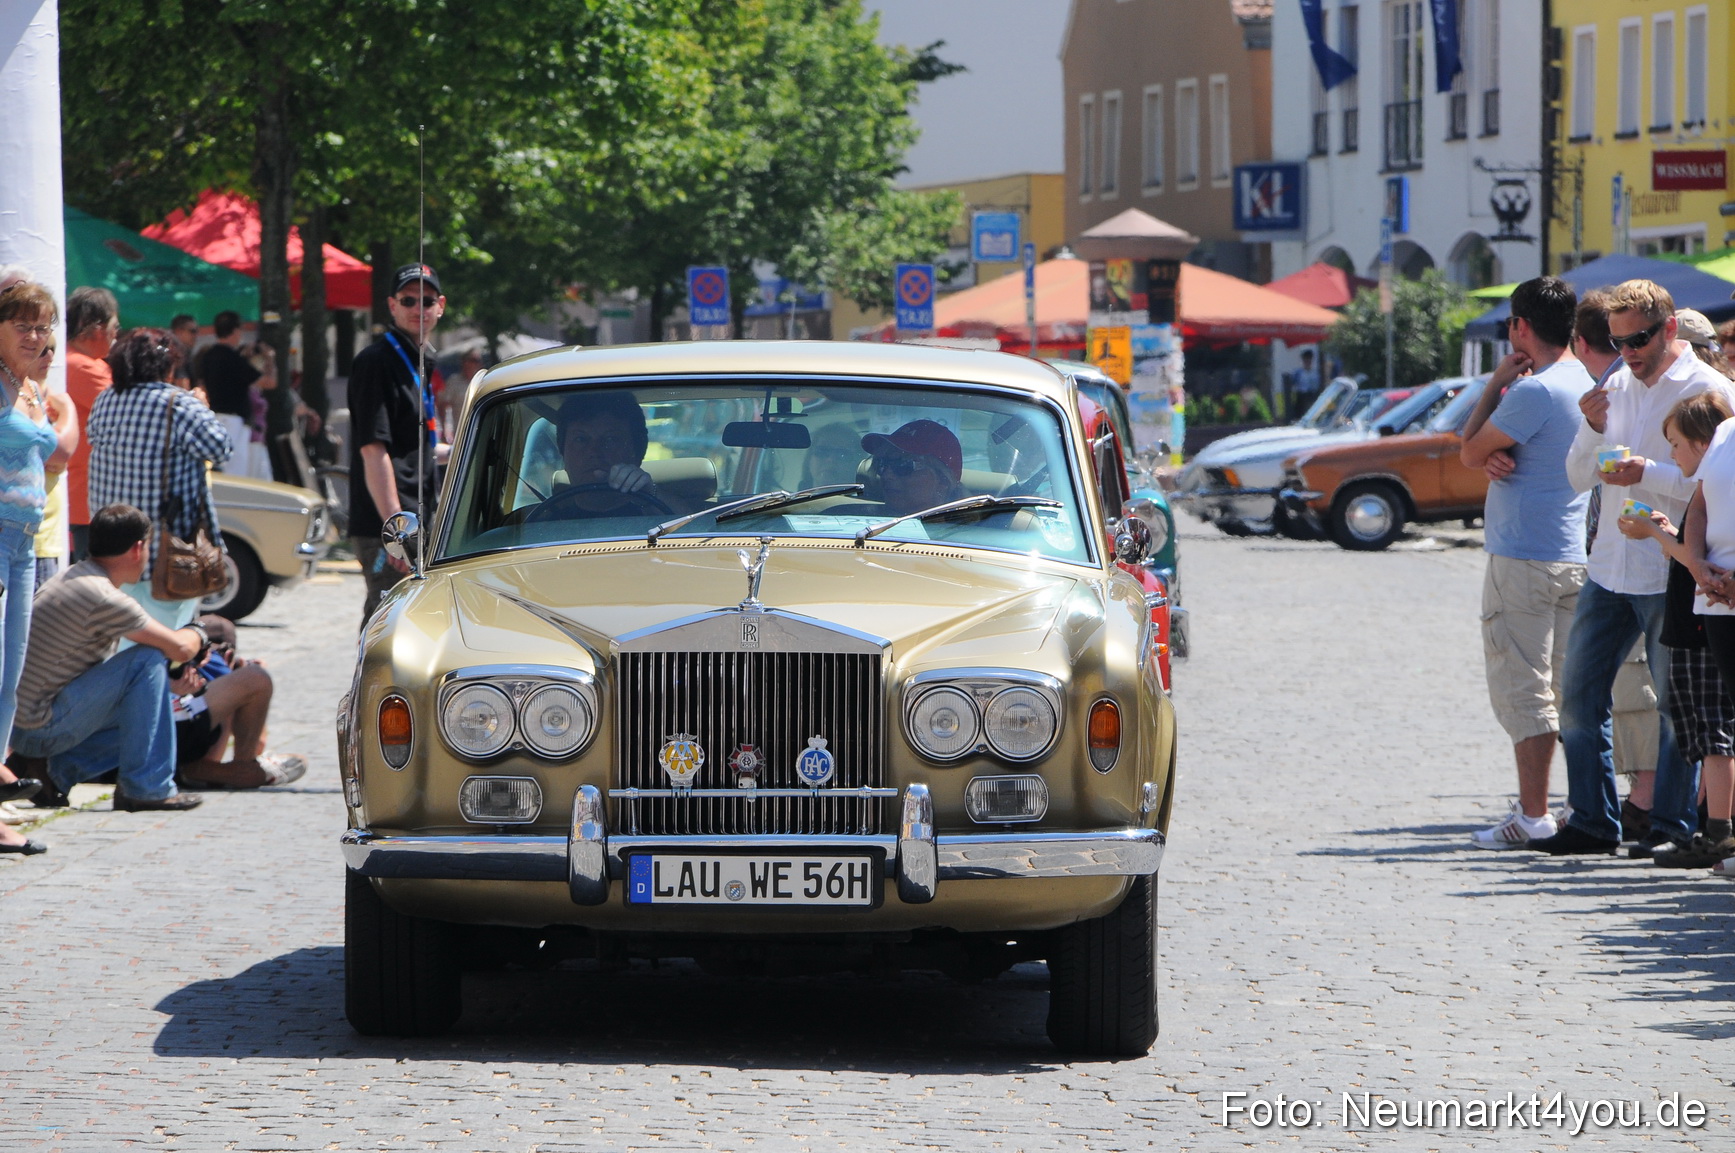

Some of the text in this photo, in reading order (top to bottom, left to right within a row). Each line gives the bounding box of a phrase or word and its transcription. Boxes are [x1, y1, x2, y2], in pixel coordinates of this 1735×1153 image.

[899, 309, 933, 325] TAXI
[804, 753, 828, 777] RAC
[637, 883, 646, 894] D
[654, 861, 868, 899] LAU WE 56H
